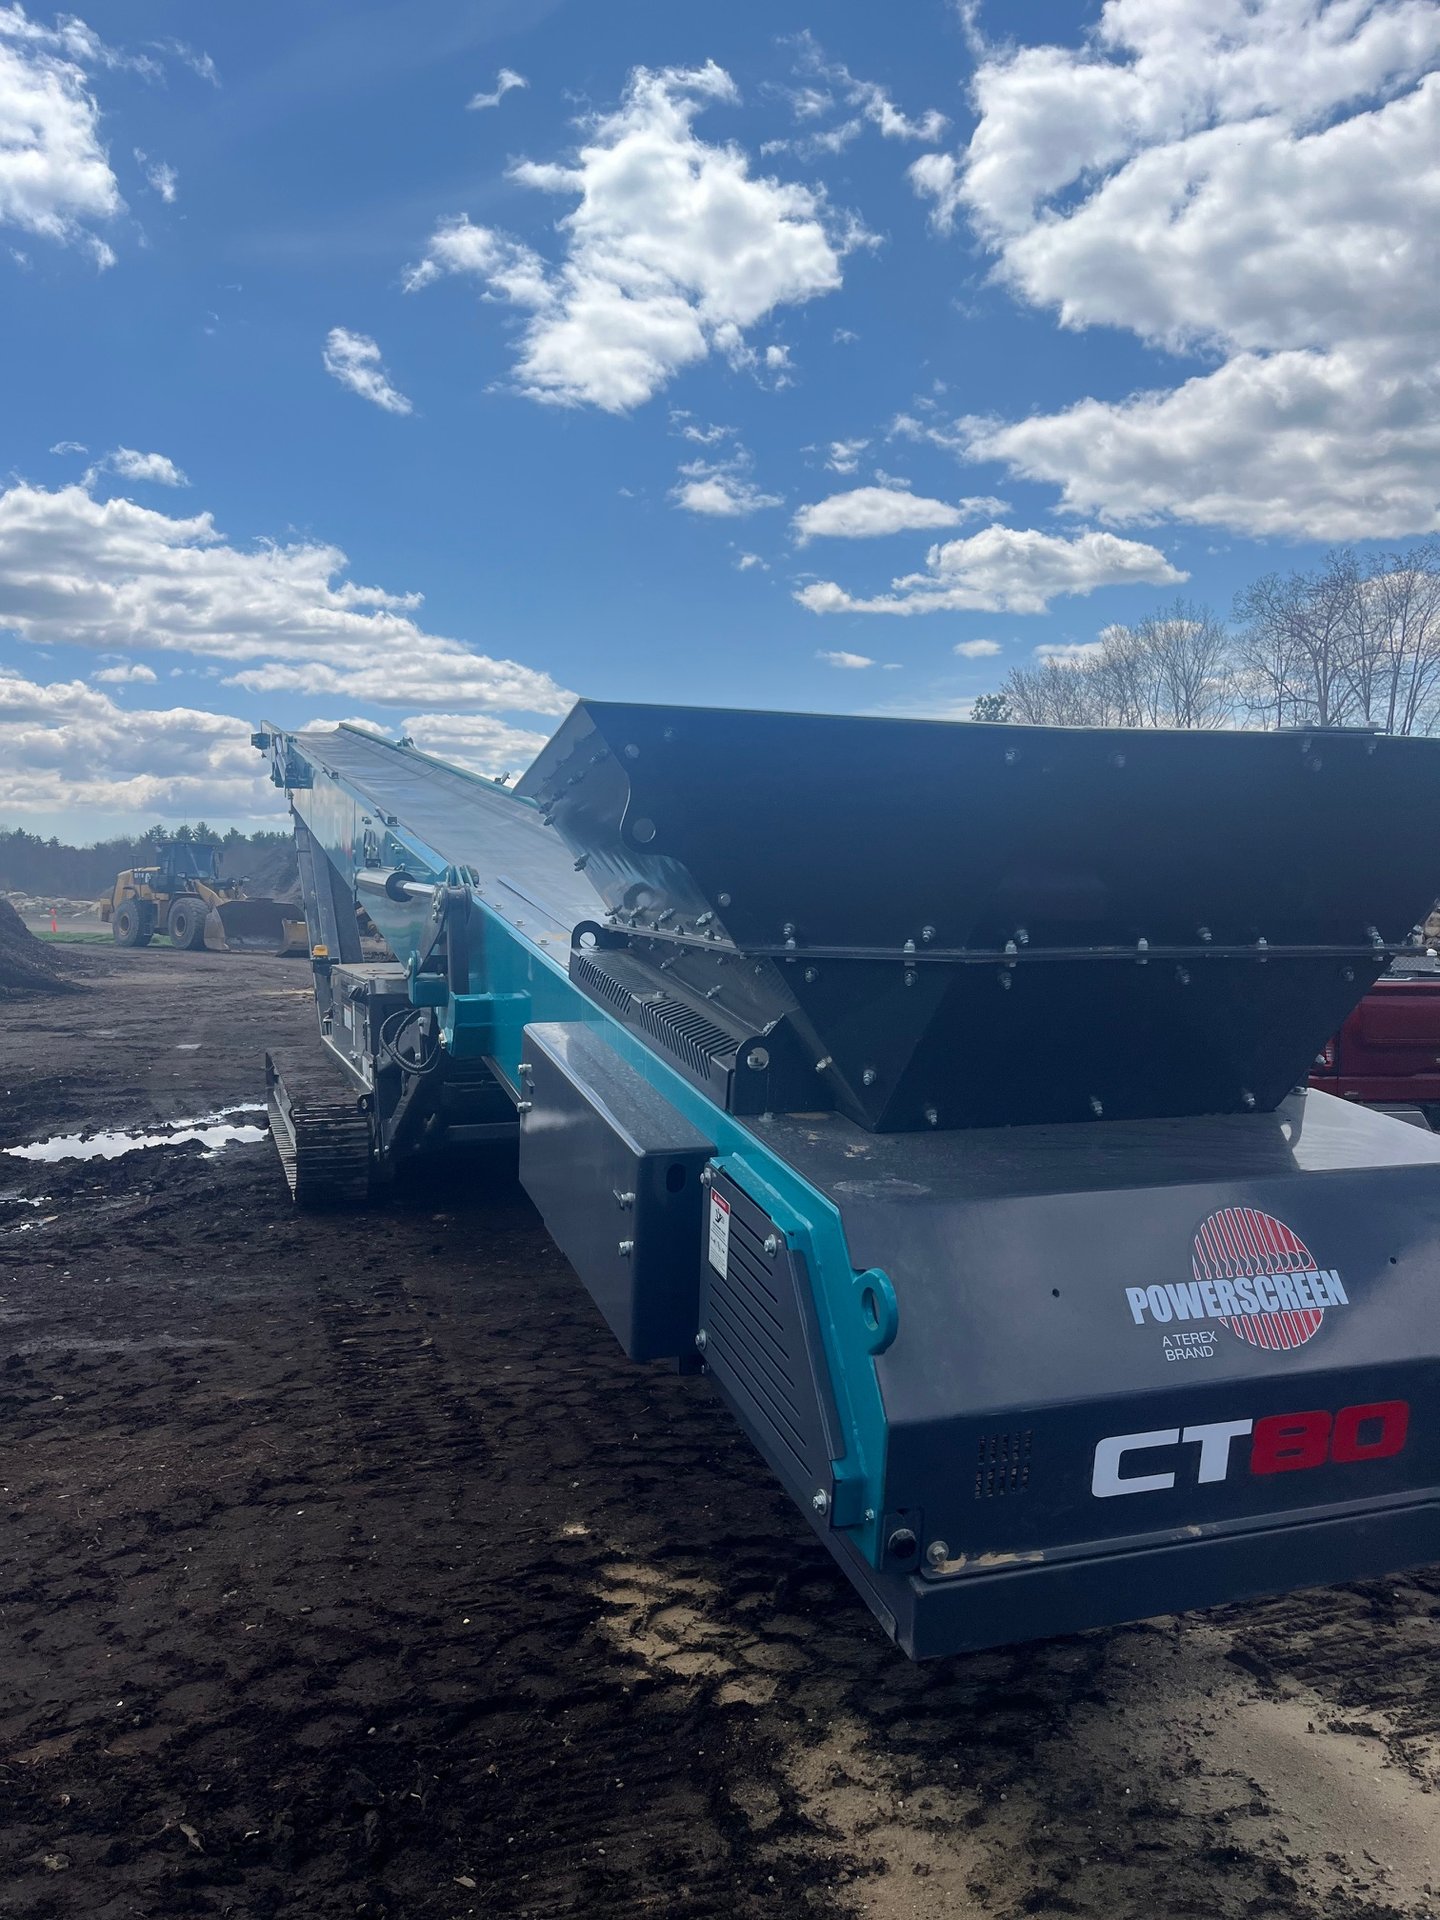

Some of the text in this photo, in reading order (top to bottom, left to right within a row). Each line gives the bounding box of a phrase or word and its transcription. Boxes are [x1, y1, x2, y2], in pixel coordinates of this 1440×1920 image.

[1125, 1270, 1349, 1325] POWERSCREEN
[1162, 1331, 1218, 1348] A TEREX
[1165, 1346, 1214, 1361] BRAND
[1091, 1399, 1409, 1498] CT80
